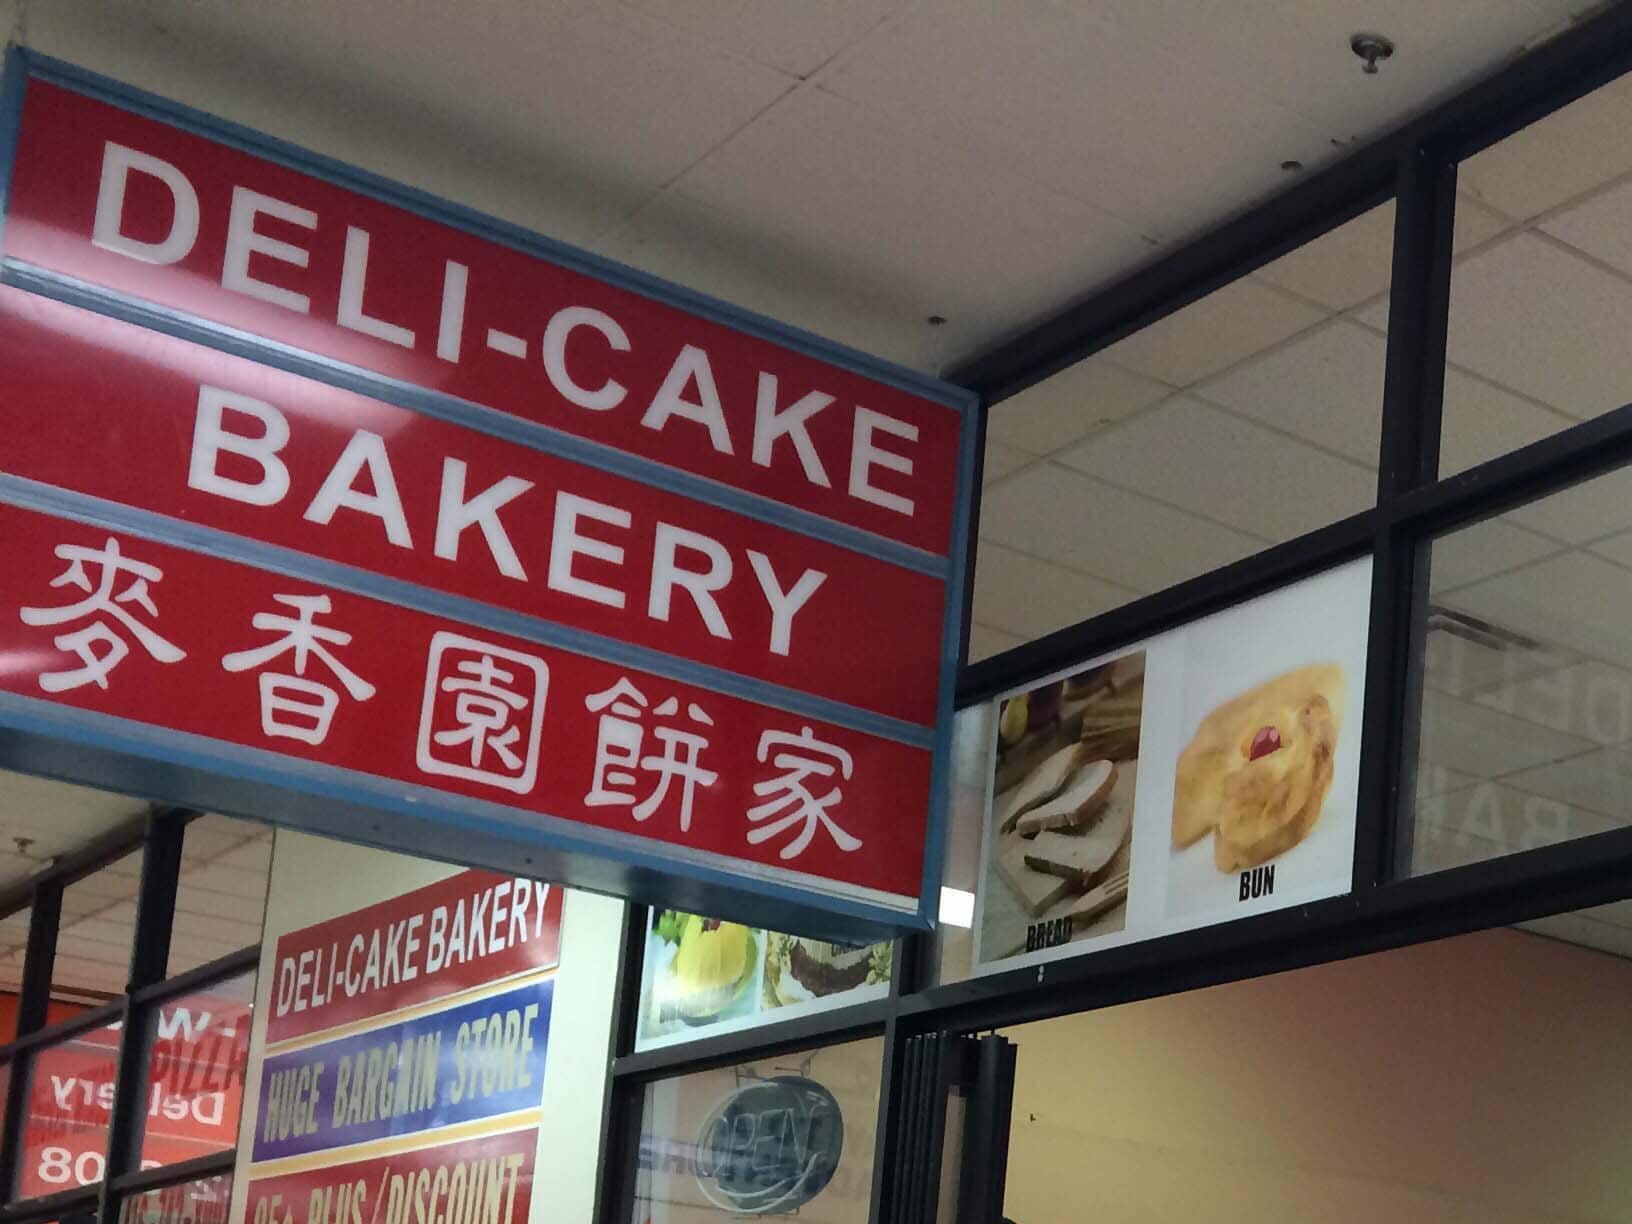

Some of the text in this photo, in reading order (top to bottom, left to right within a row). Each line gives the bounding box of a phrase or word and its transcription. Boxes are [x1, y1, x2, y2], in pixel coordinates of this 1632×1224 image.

[91, 140, 920, 518] DELI-CAKE
[187, 384, 828, 657] BAKERY
[18, 536, 862, 860] 麥香園餅家
[276, 878, 550, 1017] DELI-CAKE BAKERY
[1026, 917, 1073, 953] BREAD
[1239, 865, 1275, 901] BUN
[264, 1003, 540, 1143] HUGE BARGAIN STORE
